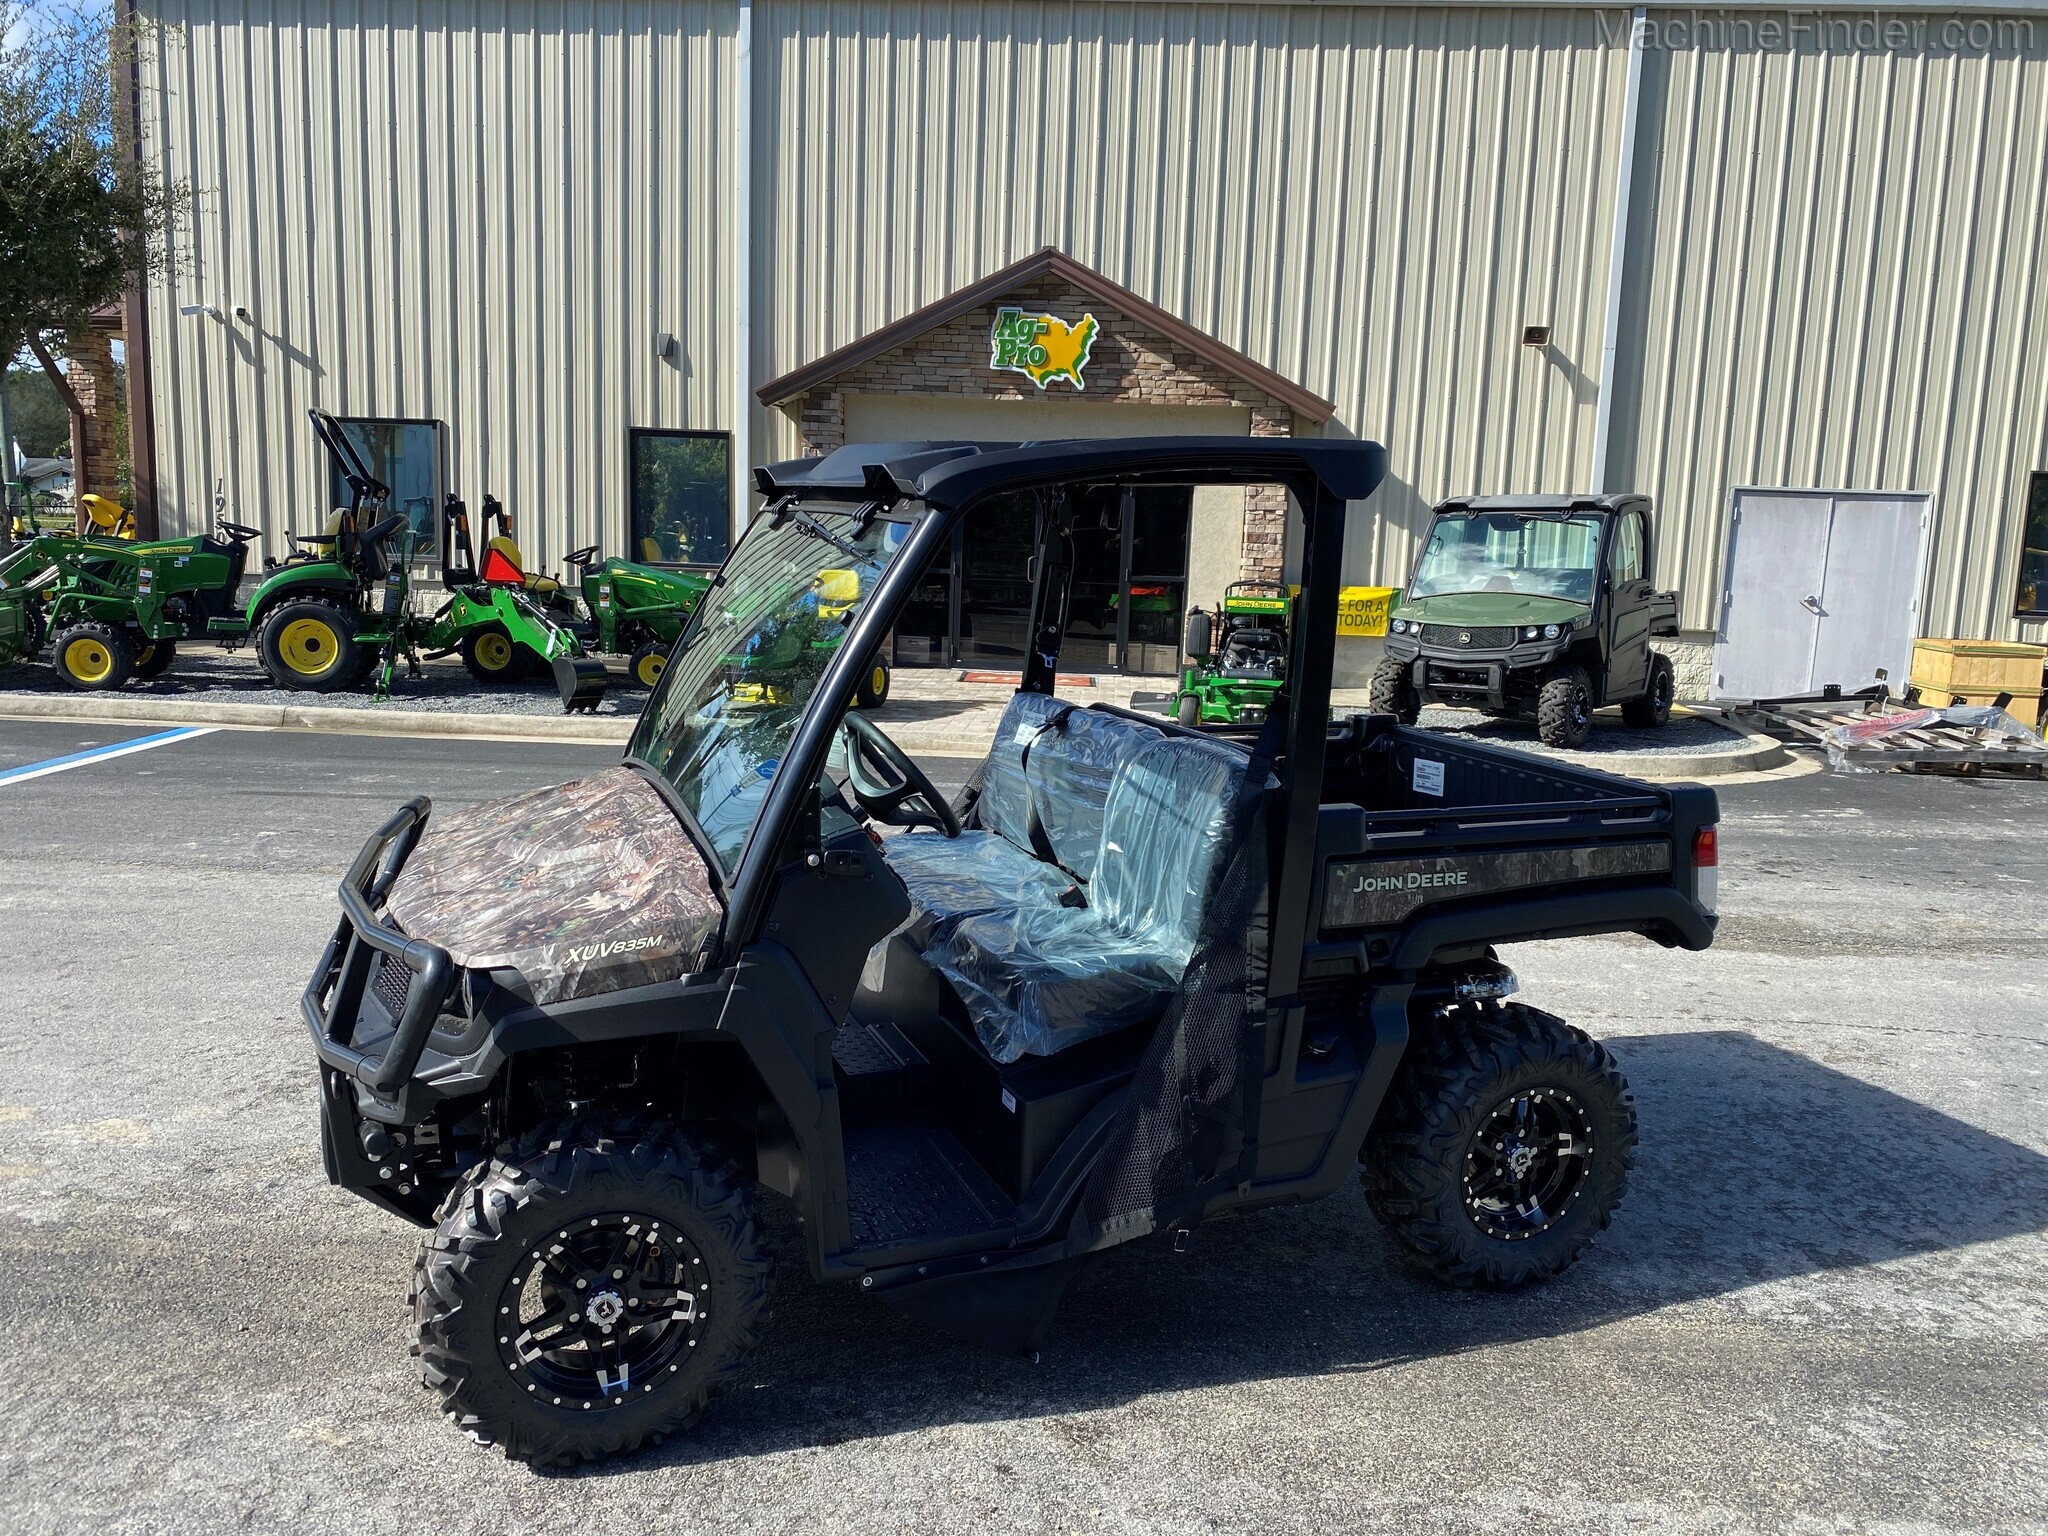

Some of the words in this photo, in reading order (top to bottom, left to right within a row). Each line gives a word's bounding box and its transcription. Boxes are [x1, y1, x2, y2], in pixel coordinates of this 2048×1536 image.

[995, 310, 1048, 343] Ag-
[994, 338, 1047, 366] Pro
[1348, 600, 1373, 612] FOR
[1375, 600, 1384, 612] A
[1338, 614, 1382, 627] TODAY!
[1353, 876, 1403, 893] JOHN
[1407, 872, 1468, 889] DEERE
[564, 934, 663, 964] XUV835M
